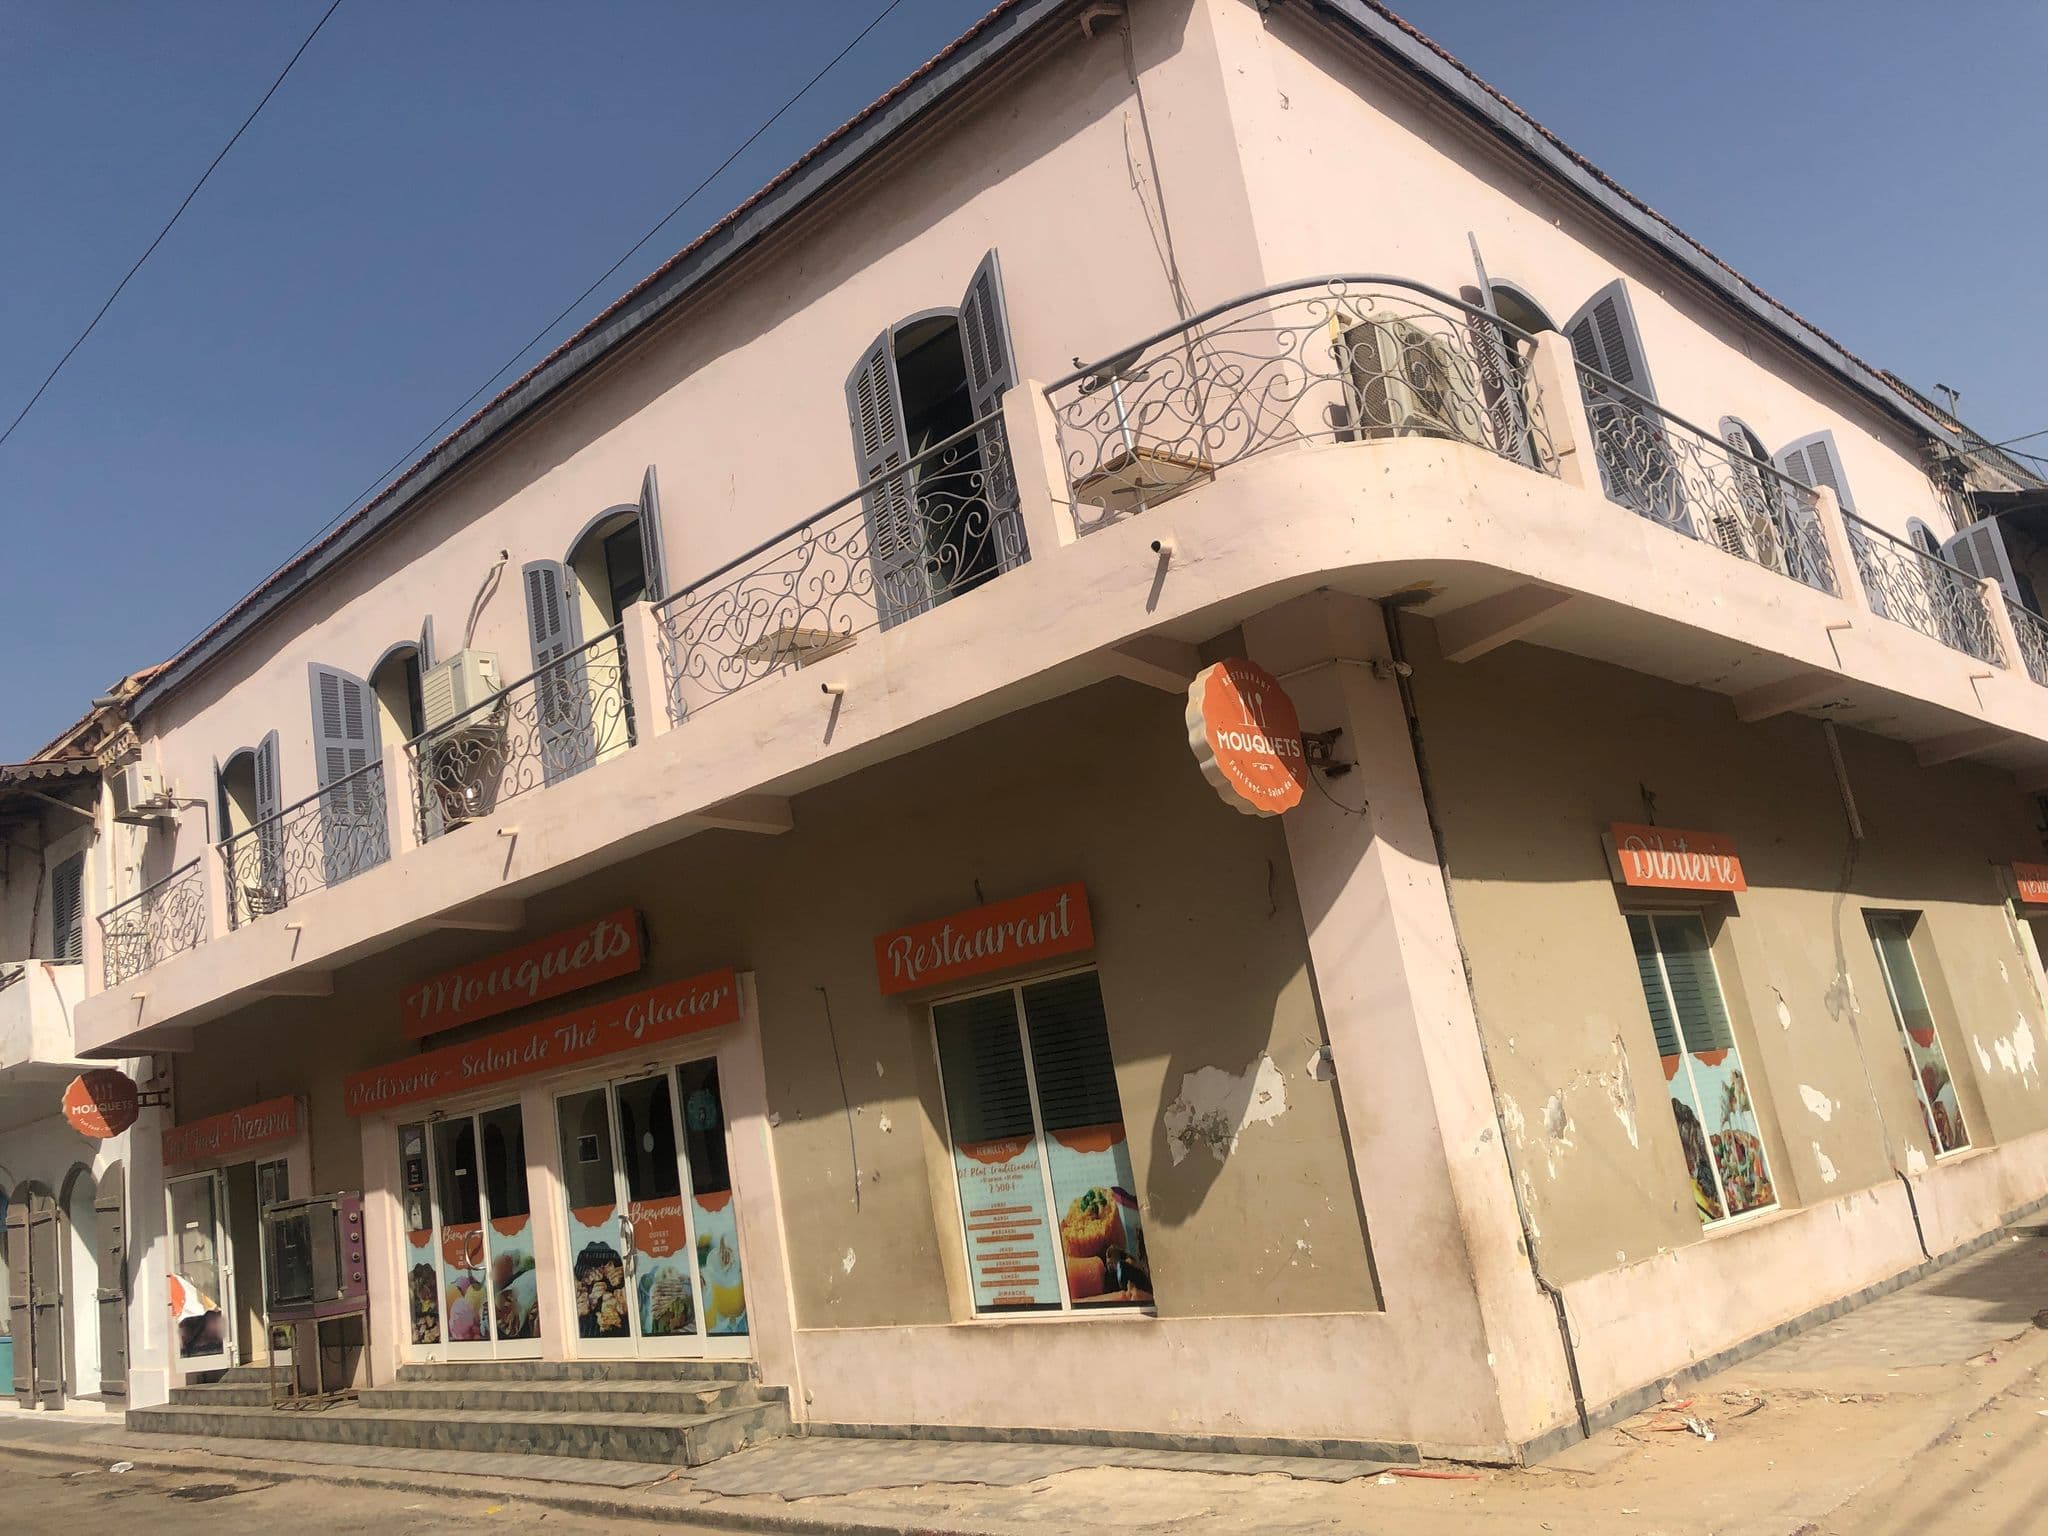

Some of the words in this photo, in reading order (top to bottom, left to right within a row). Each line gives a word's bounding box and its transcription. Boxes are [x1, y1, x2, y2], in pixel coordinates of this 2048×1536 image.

[1216, 729, 1301, 758] MOUQUETS
[1624, 831, 1738, 885] Dibiterie
[406, 919, 632, 1019] Mouquets
[887, 893, 1076, 982] Restaurant
[461, 1046, 519, 1079] Salon
[523, 1033, 549, 1063] de
[554, 1020, 598, 1055] Thé
[623, 981, 729, 1039] Glacier
[629, 1203, 683, 1225] Bienvenue
